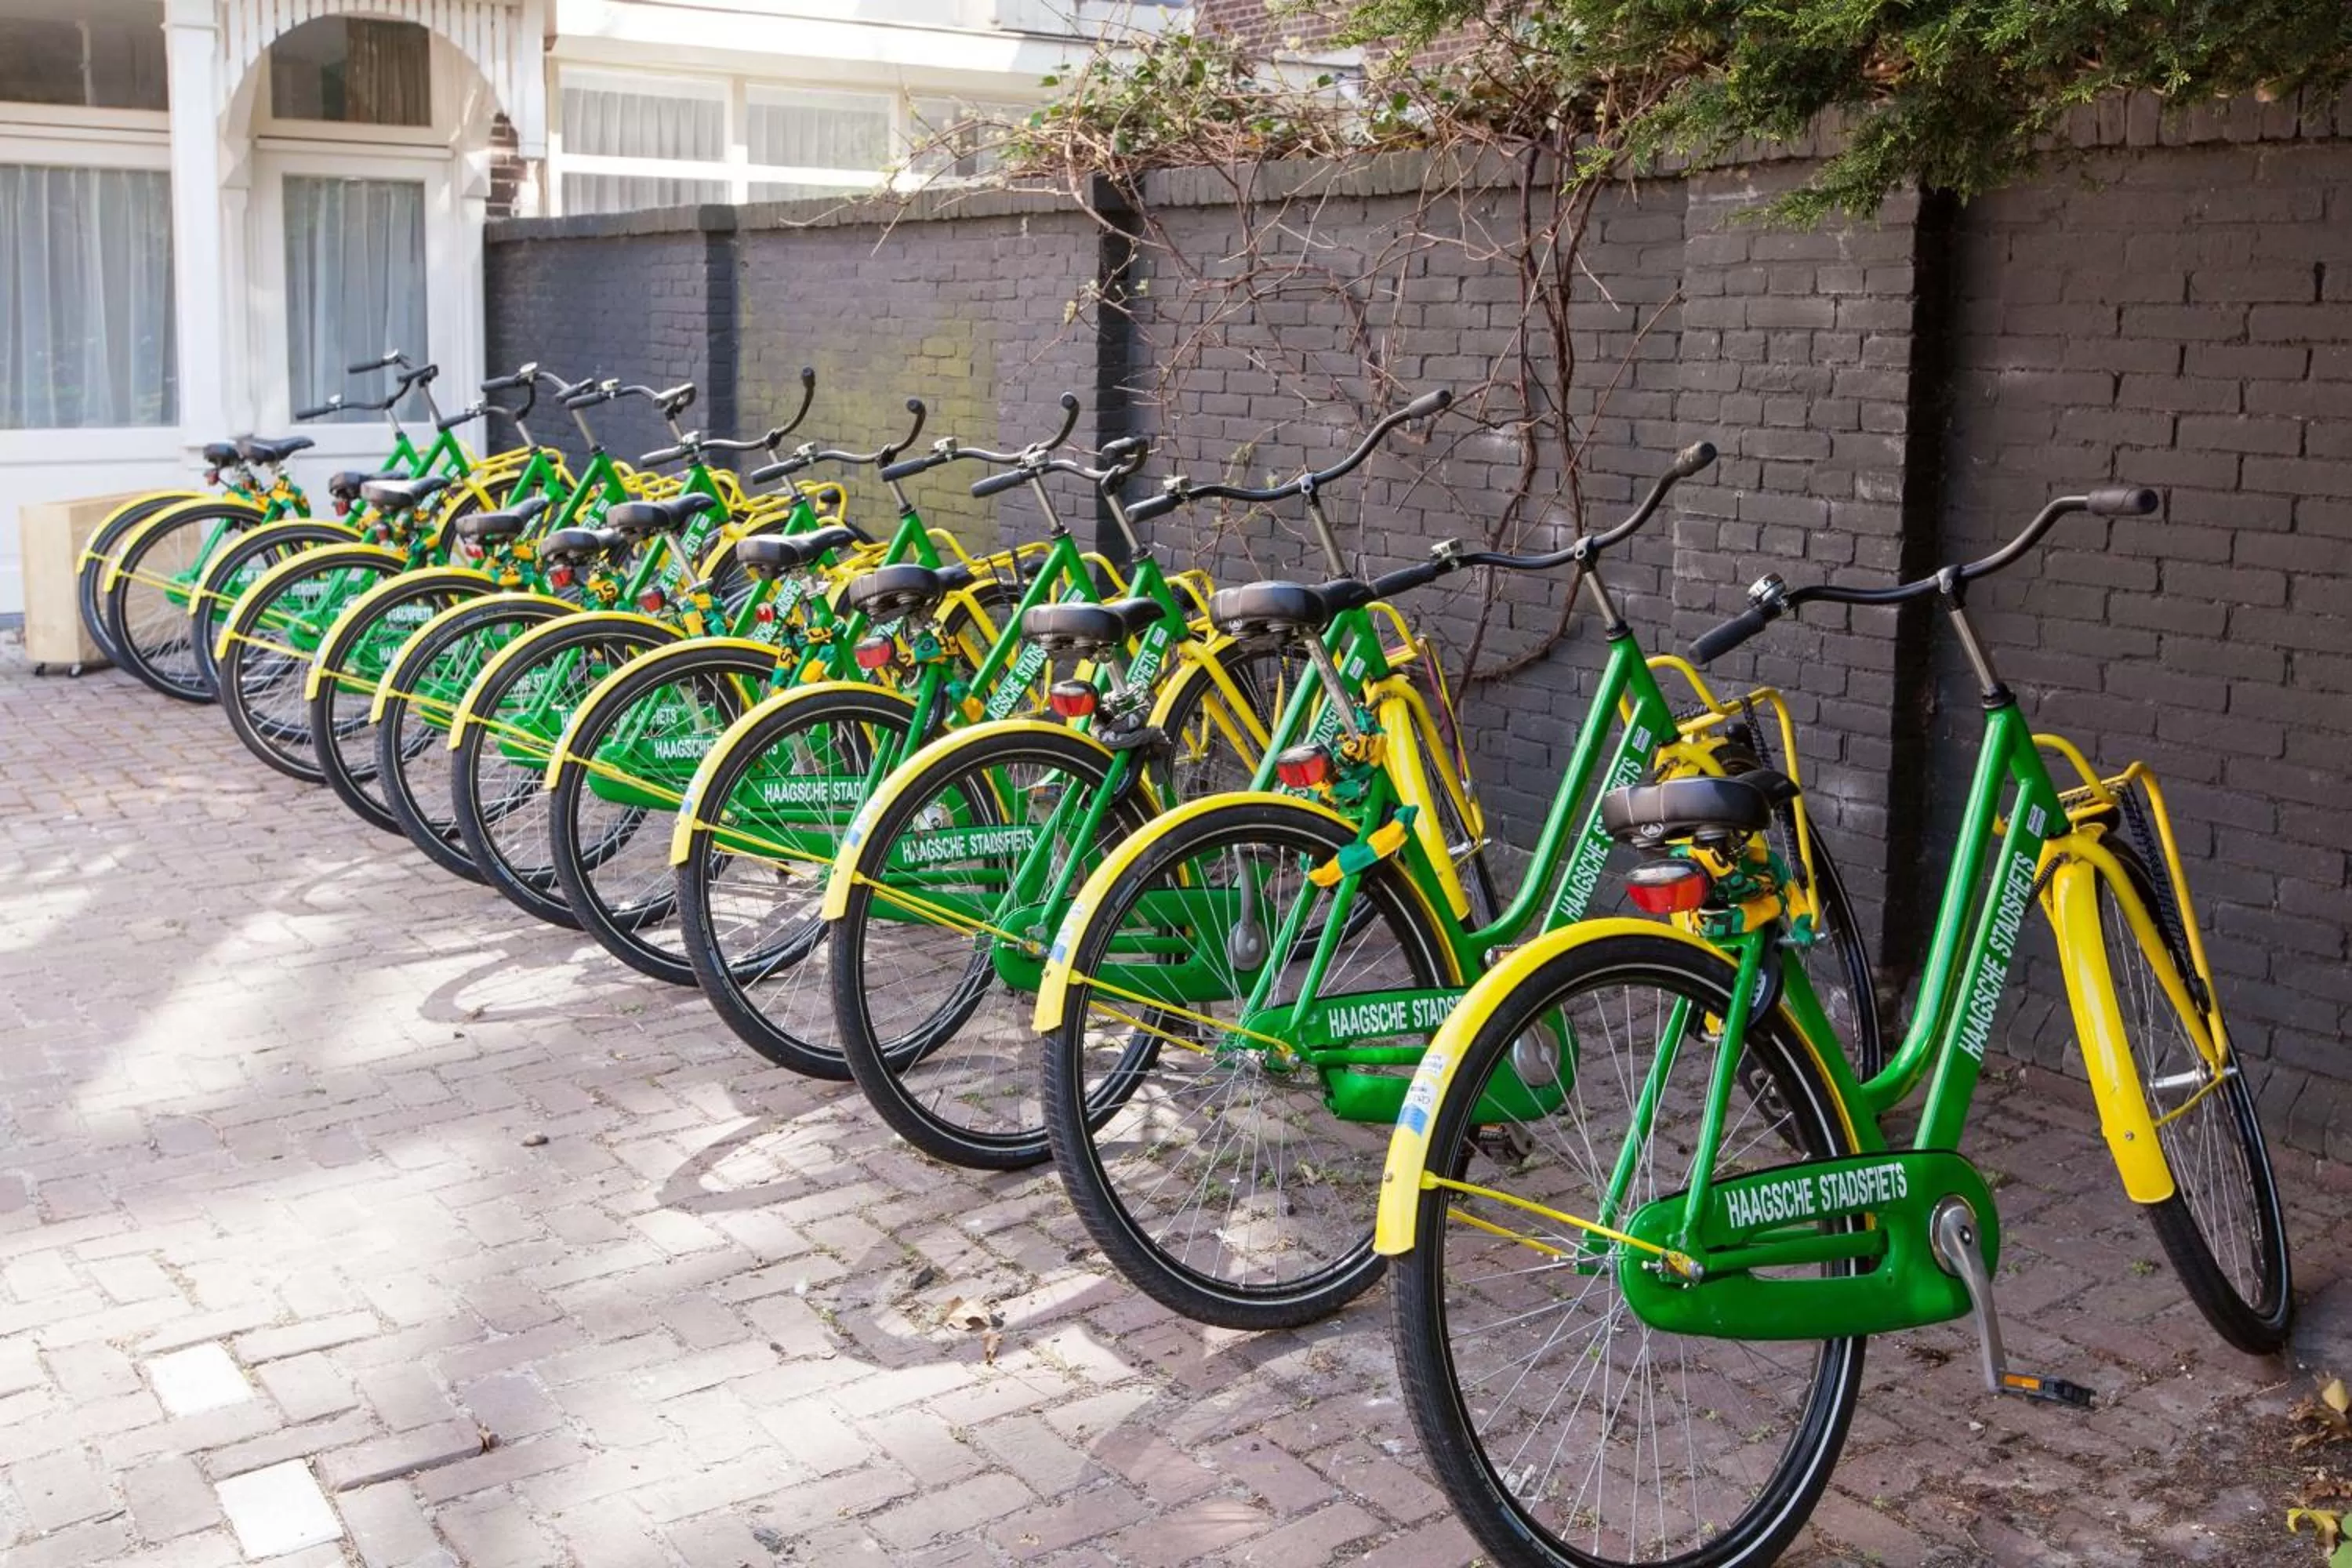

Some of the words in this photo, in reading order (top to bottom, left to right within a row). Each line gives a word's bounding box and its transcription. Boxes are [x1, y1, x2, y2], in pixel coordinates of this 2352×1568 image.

[987, 677, 1026, 720] AGSCHE
[1015, 647, 1048, 681] STADS
[764, 782, 829, 803] HAAGSCHE
[969, 829, 1034, 855] STADSFIETS
[1559, 837, 1609, 923] HAAGSCHE
[1958, 953, 2007, 1062] HAAGSCHE
[1988, 851, 2037, 958] STADSFIETS
[1328, 1001, 1408, 1039] HAAGSCHE
[1412, 995, 1463, 1029] STADS
[1725, 1178, 1816, 1229] HAAGSCHE
[1819, 1162, 1908, 1212] STADSFIETS
